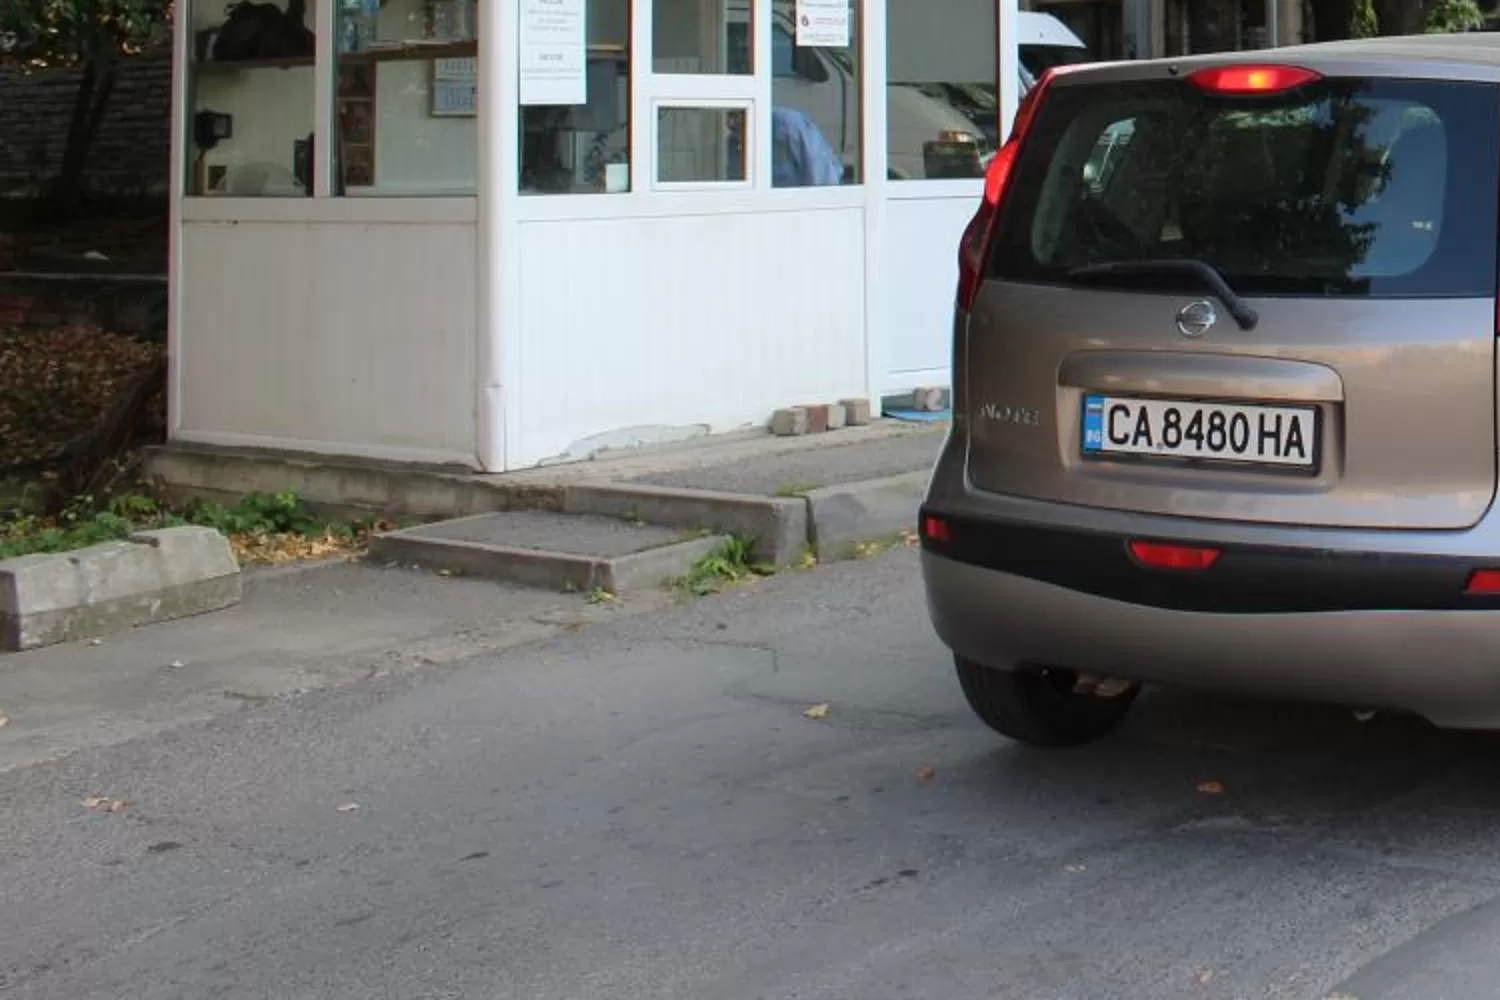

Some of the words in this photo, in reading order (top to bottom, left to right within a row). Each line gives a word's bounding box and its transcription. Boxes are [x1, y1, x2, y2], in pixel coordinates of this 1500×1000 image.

[1108, 403, 1153, 447] CA
[1161, 407, 1250, 454] 8480
[1257, 412, 1306, 459] HA
